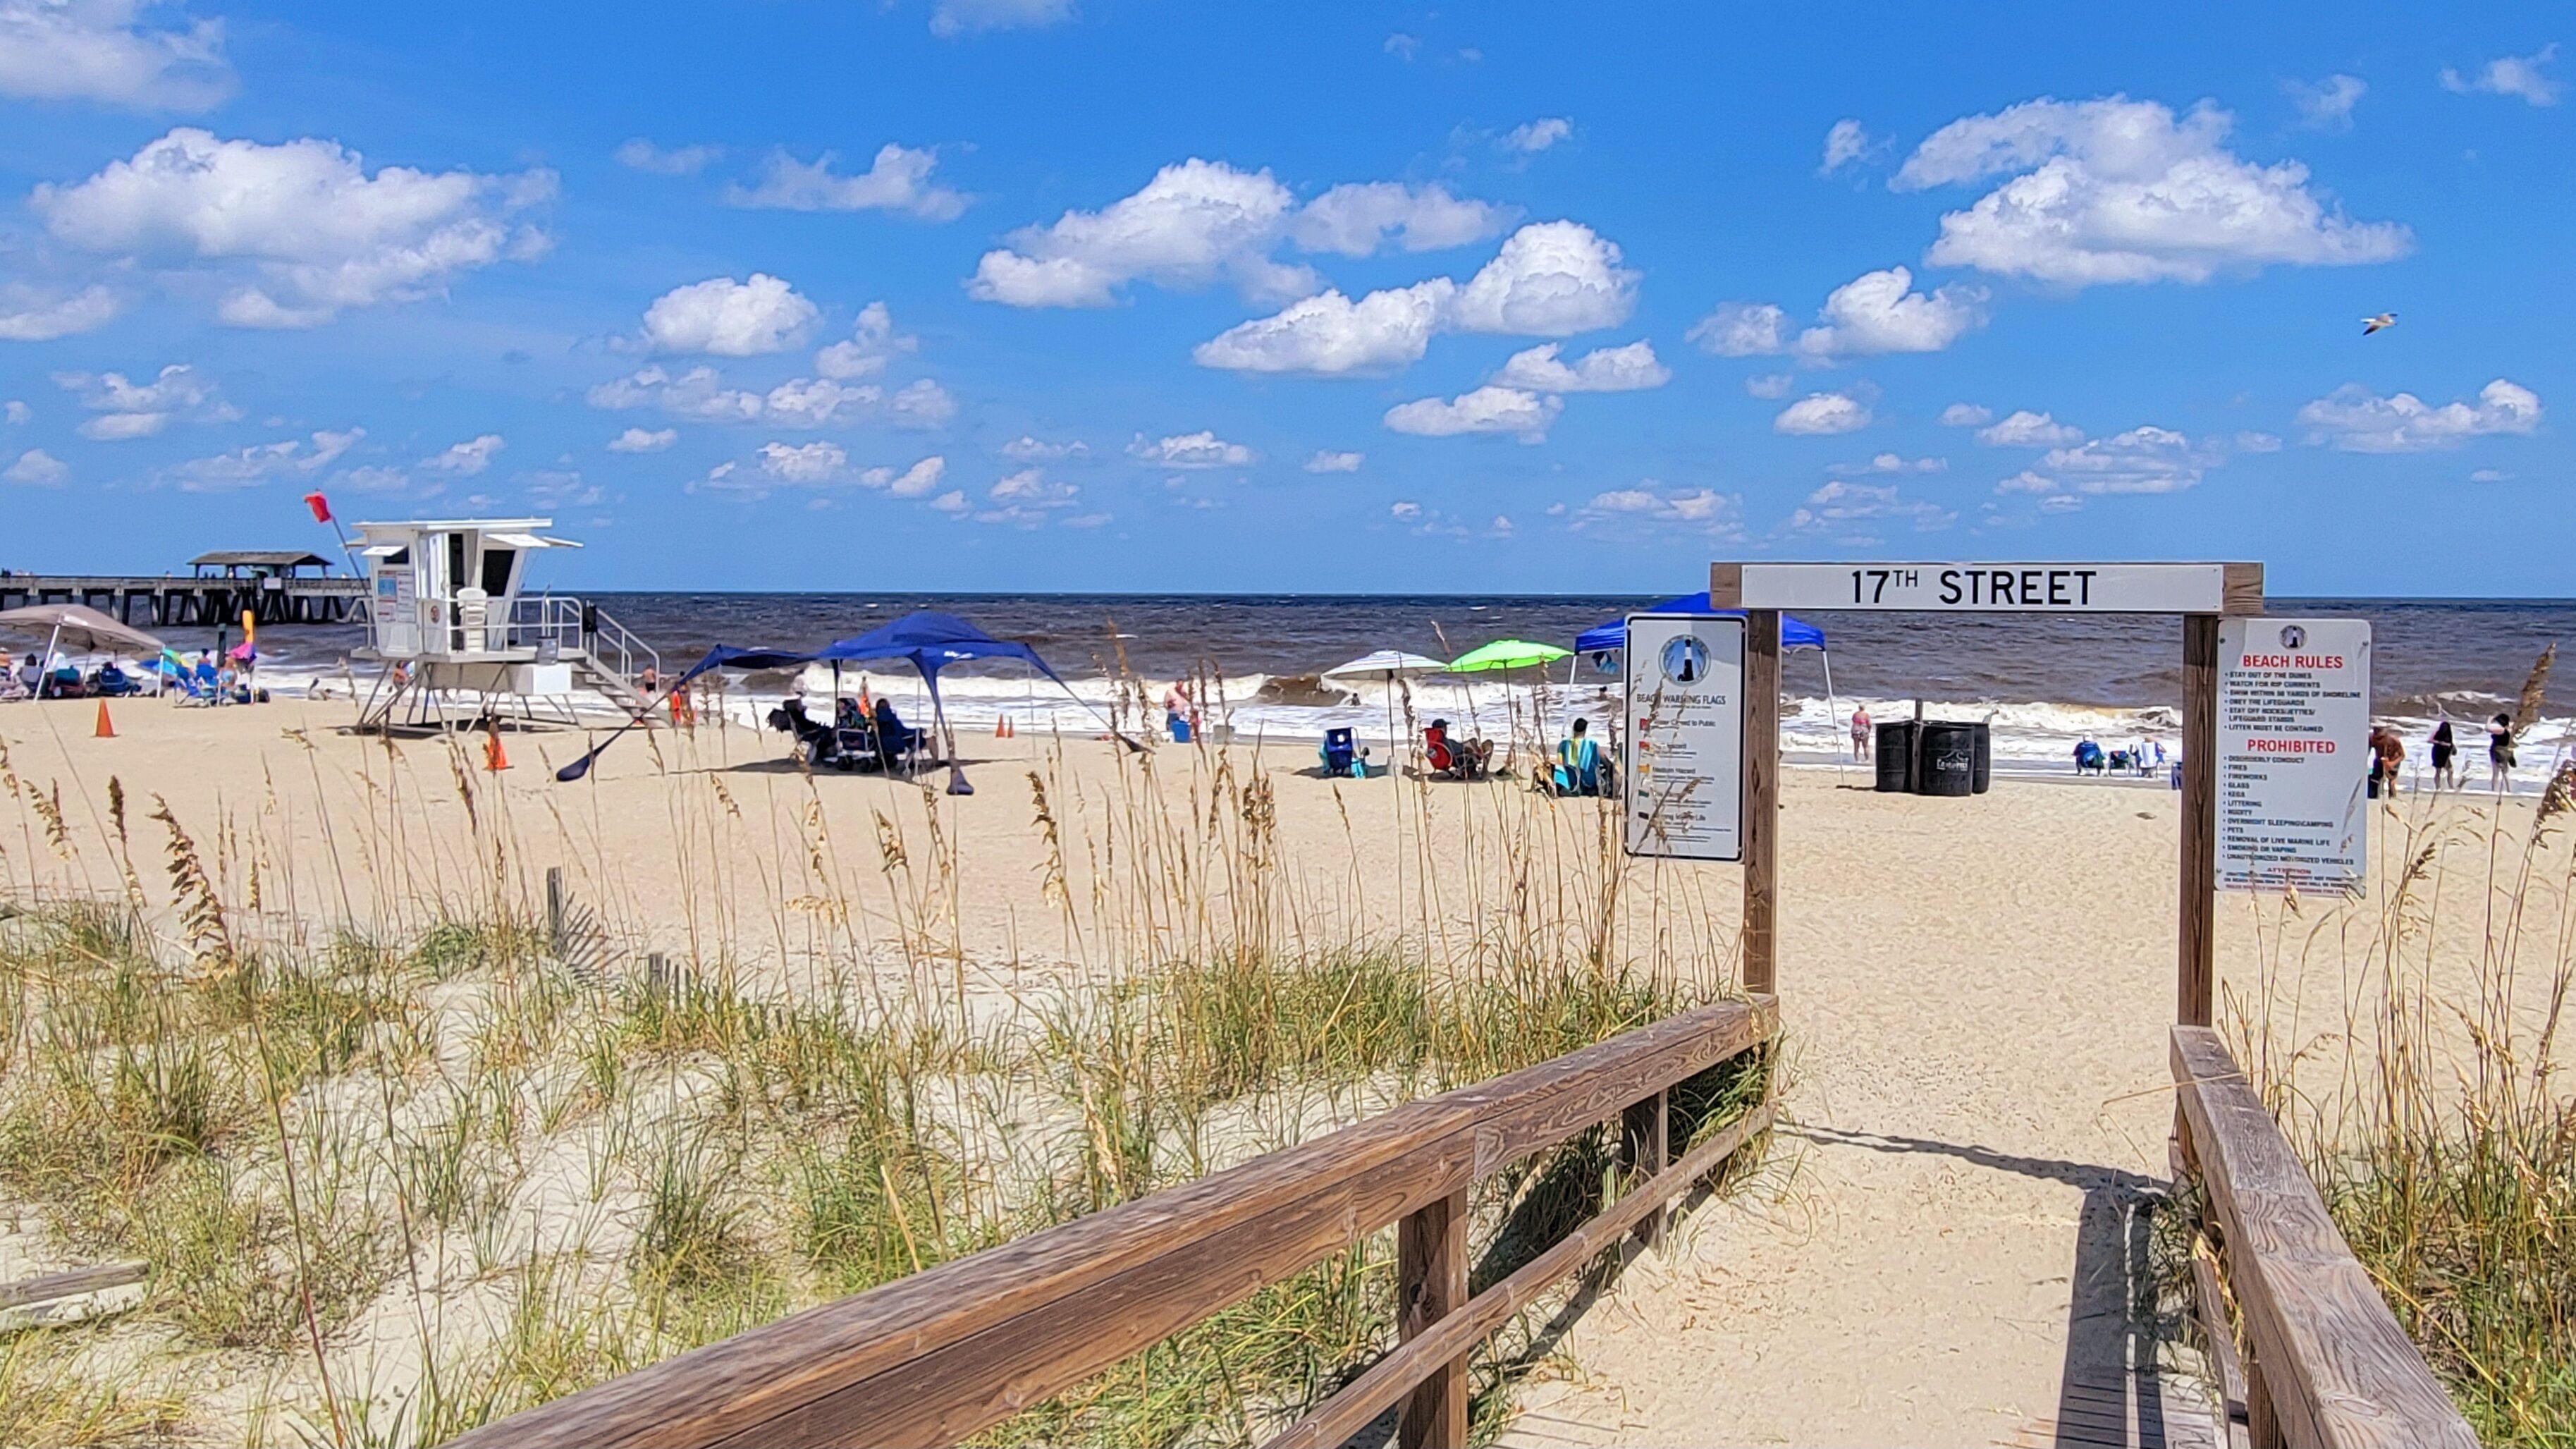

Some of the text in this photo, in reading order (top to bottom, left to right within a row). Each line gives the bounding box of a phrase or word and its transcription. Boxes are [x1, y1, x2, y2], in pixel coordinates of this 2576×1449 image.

[1938, 570, 2097, 605] STREET
[2243, 654, 2343, 668] BEACH RULES
[1636, 693, 1660, 703] BEAC
[1703, 695, 1726, 705] FLAGS
[2247, 739, 2336, 753] PROHIBITED
